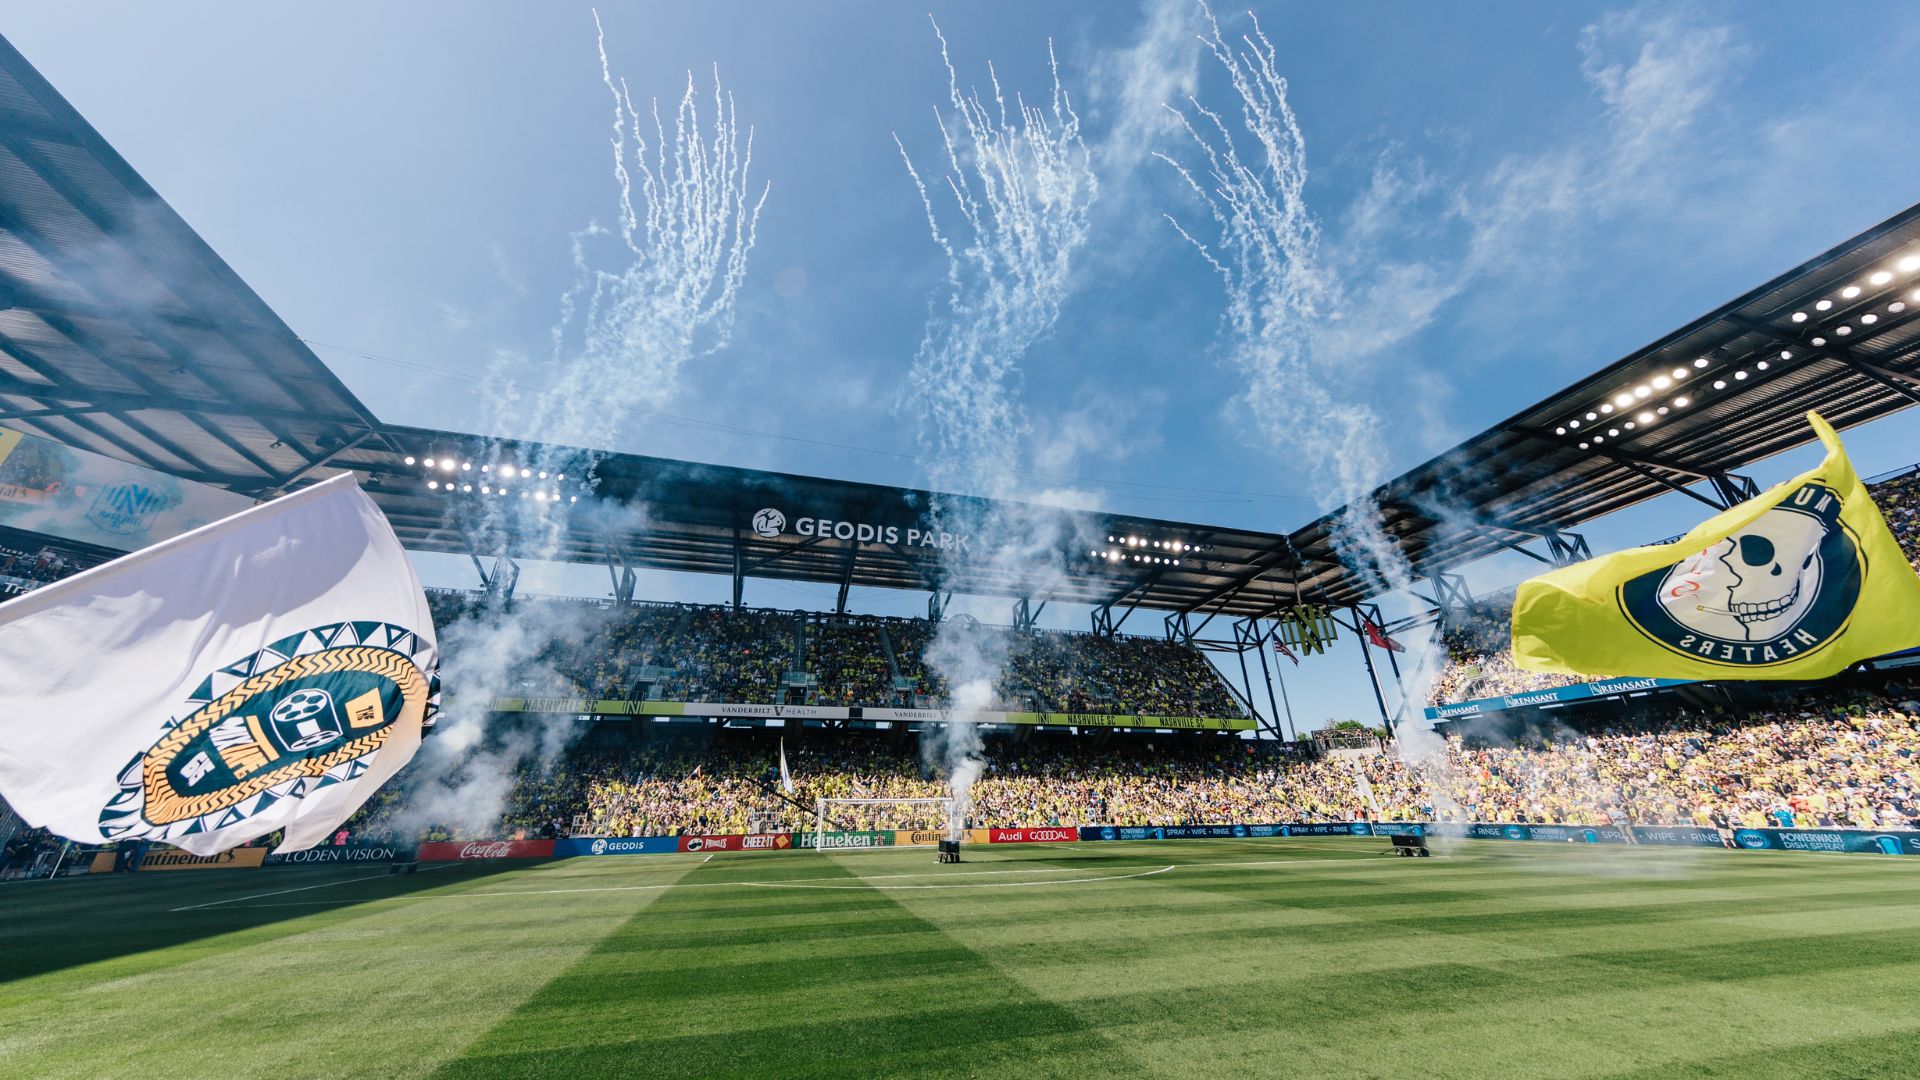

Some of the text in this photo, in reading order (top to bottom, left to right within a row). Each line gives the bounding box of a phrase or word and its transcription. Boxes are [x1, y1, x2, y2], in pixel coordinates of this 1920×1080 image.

[795, 517, 970, 551] GEODIS PARK
[1600, 678, 1657, 695] RENASANT
[522, 698, 599, 712] NASHVILLE SC
[1513, 693, 1558, 706] RENASANT
[1441, 704, 1480, 717] RENASANT
[1067, 714, 1116, 726] NASHVILLE SC
[1160, 717, 1205, 728] NASHVILLE SC
[911, 830, 965, 844] Contineal
[998, 832, 1022, 841] Audi
[1477, 828, 1501, 836] RINSE
[1646, 832, 1677, 841] WIPE
[1690, 832, 1720, 843] RINS
[1779, 833, 1843, 843] POWERWASH
[608, 842, 644, 851] GEODIS
[801, 833, 871, 848] Heineken
[140, 851, 220, 866] ntinental
[285, 848, 338, 863] LODEN
[344, 847, 396, 861] VISION
